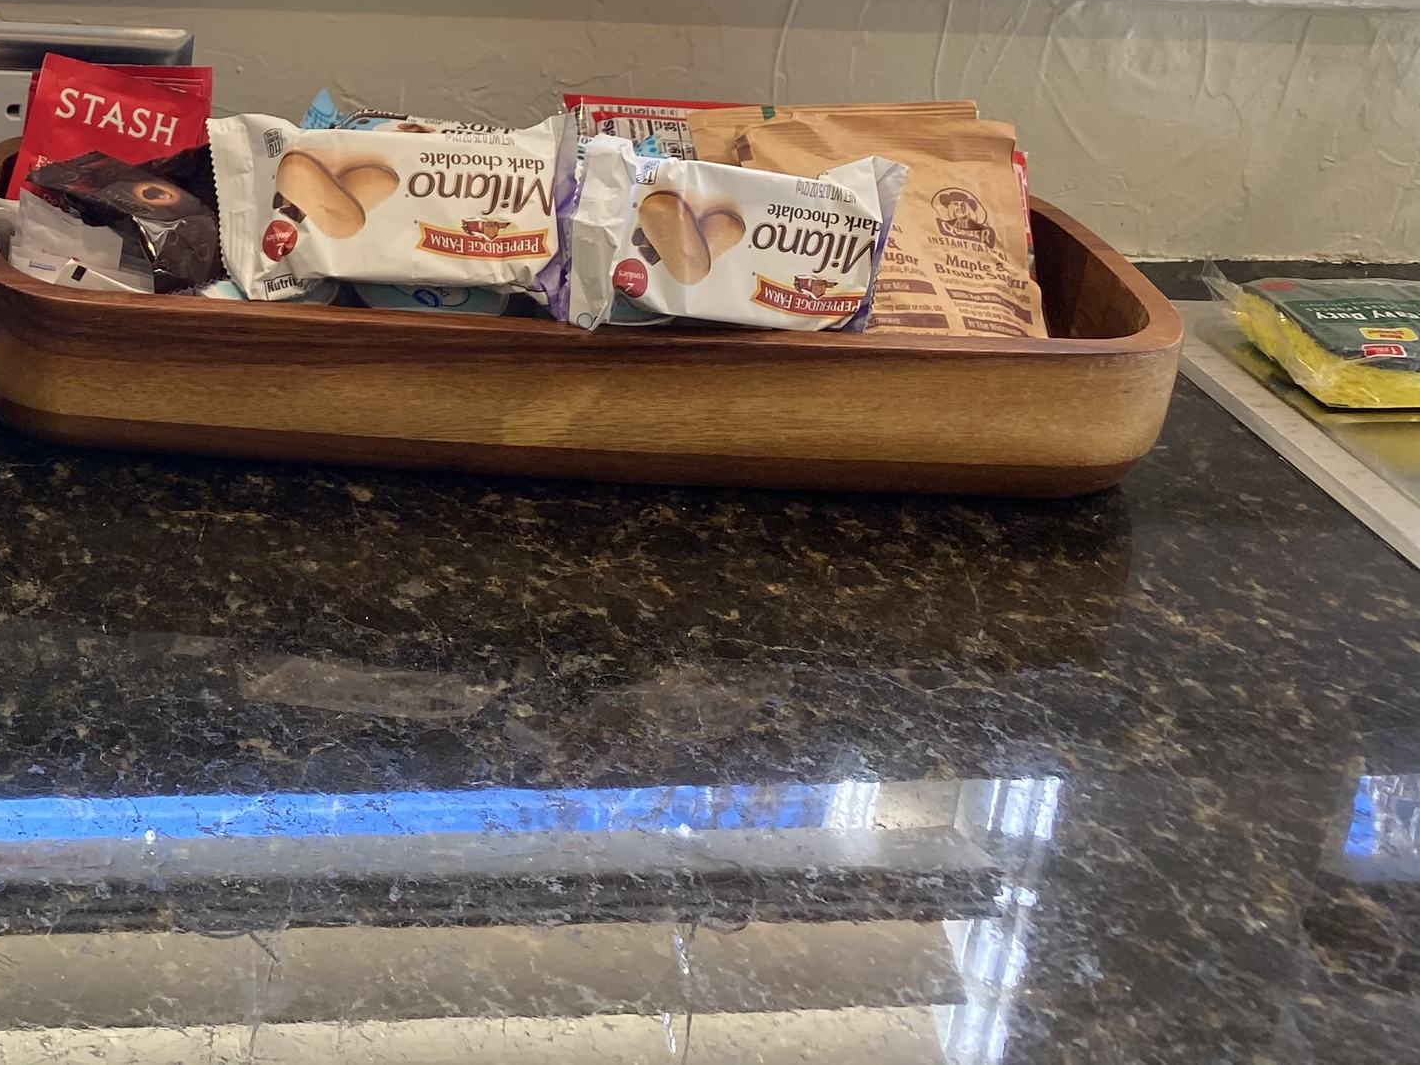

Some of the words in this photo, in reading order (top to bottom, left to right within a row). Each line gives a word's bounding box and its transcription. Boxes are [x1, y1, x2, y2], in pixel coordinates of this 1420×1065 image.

[55, 88, 179, 146] STASH
[268, 141, 282, 156] 110
[420, 151, 503, 171] chocolate
[507, 156, 545, 174] dark
[409, 171, 554, 216] Milano
[767, 203, 839, 230] chocolate
[845, 214, 881, 236] dark
[275, 242, 285, 256] 2
[430, 233, 464, 253] FARM
[467, 237, 539, 254] PEPPERIDGE
[886, 237, 903, 251] &
[928, 236, 968, 249] INSTANT
[883, 251, 919, 266] ugar
[946, 254, 991, 272] Maple
[996, 262, 1011, 275] &
[618, 270, 645, 280] cookies
[934, 263, 985, 281] Brown
[986, 272, 1029, 290] Sugar
[624, 282, 635, 294] 2
[764, 287, 793, 308] FARM
[794, 296, 863, 314] PEPPERIDGE
[1316, 311, 1368, 320] Duty
